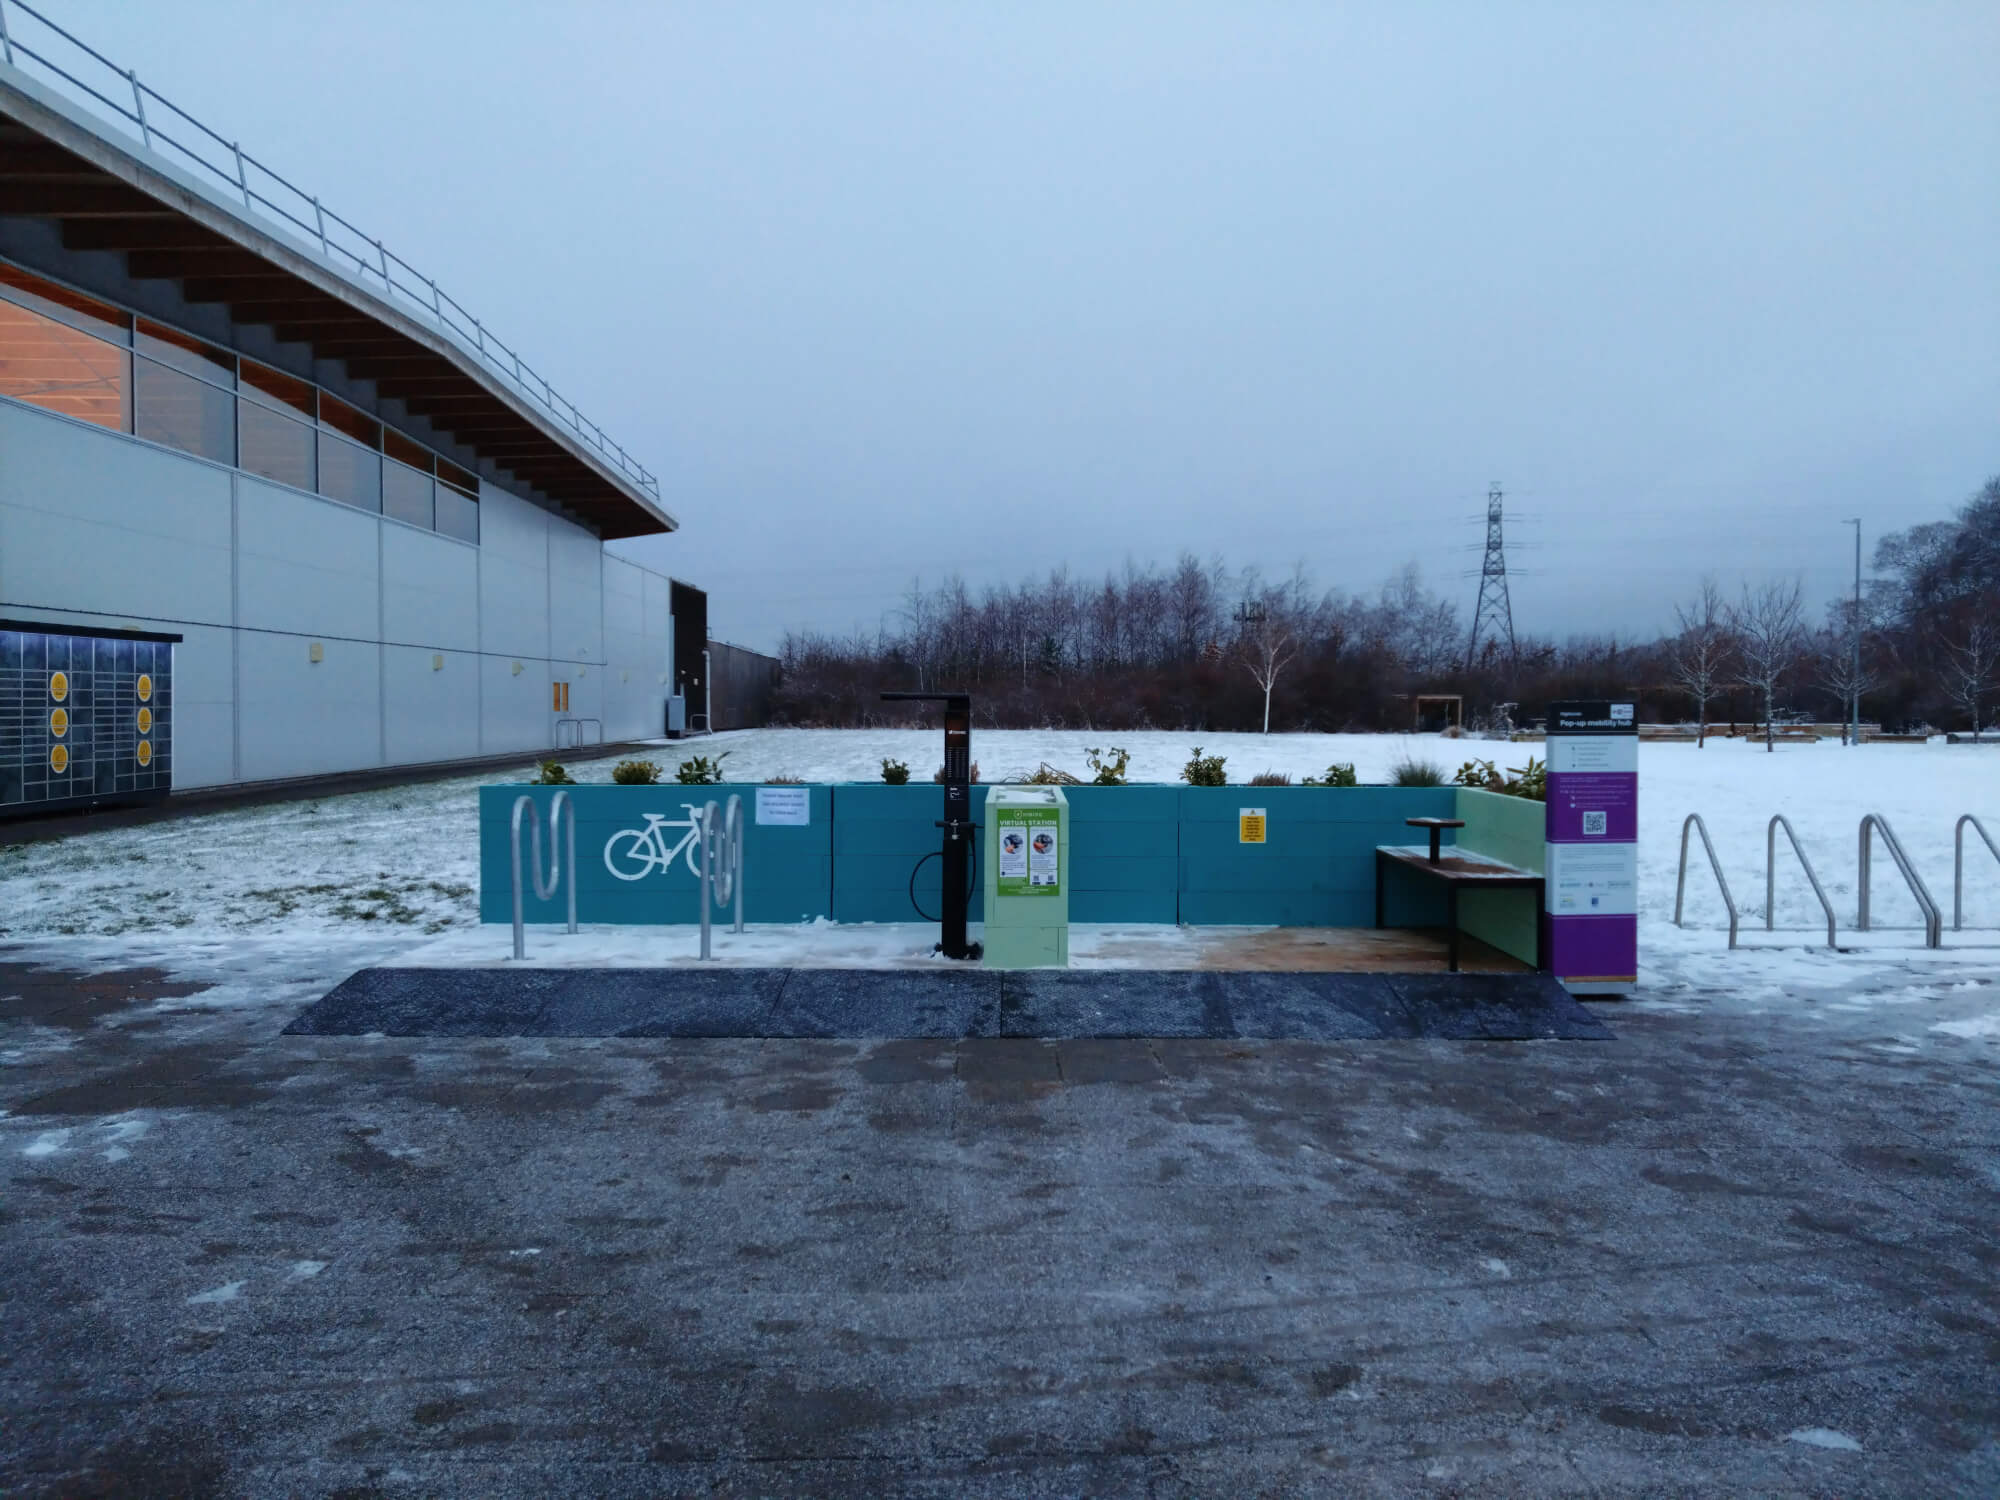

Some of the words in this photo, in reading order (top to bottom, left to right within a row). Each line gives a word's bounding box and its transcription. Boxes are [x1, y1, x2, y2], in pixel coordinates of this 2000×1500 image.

[1560, 719, 1586, 727] Pop-up
[1588, 719, 1616, 728] mobility
[1618, 719, 1632, 727] hub
